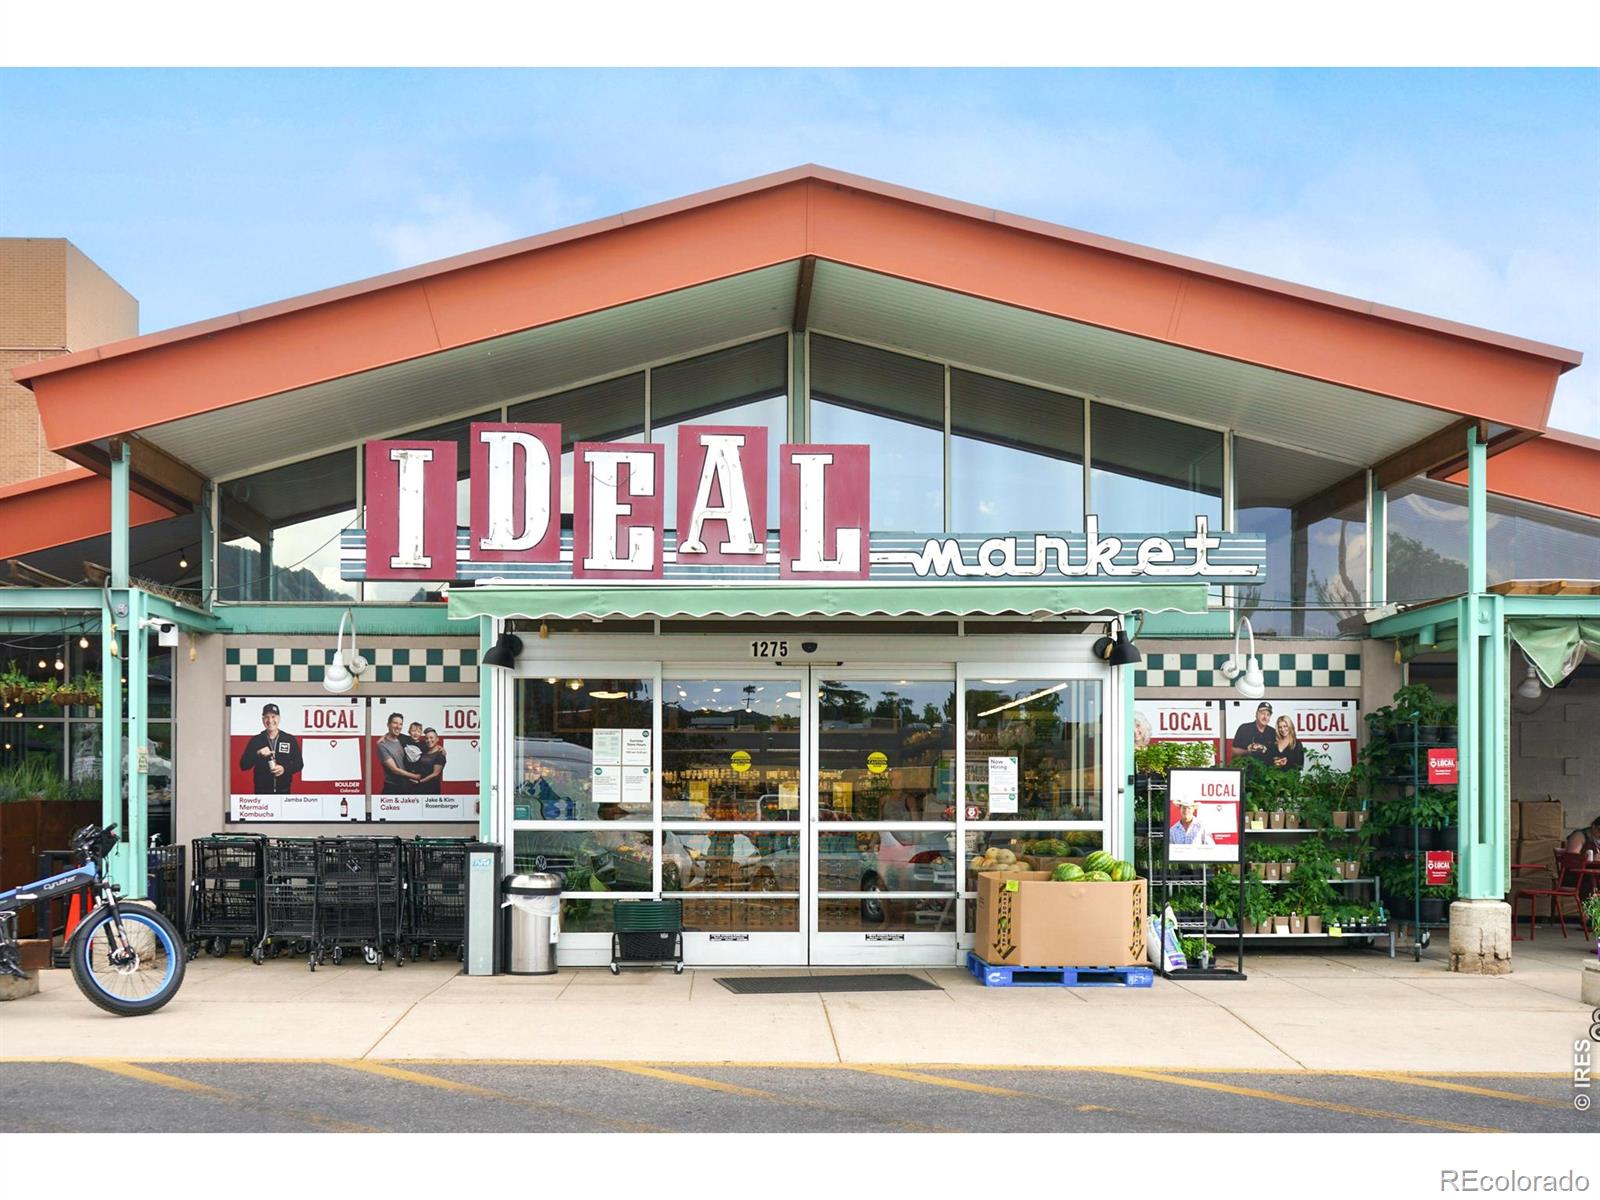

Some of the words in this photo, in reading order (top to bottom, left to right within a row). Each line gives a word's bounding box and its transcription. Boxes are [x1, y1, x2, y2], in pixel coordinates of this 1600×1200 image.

[388, 430, 862, 571] IDEAL
[911, 514, 1259, 577] market
[751, 641, 788, 657] 1275
[304, 709, 358, 729] LOCAL
[445, 709, 480, 729] LOC
[1159, 712, 1212, 731] LOCAL
[1297, 713, 1349, 732] LOCAL
[1201, 783, 1237, 797] LOCAL
